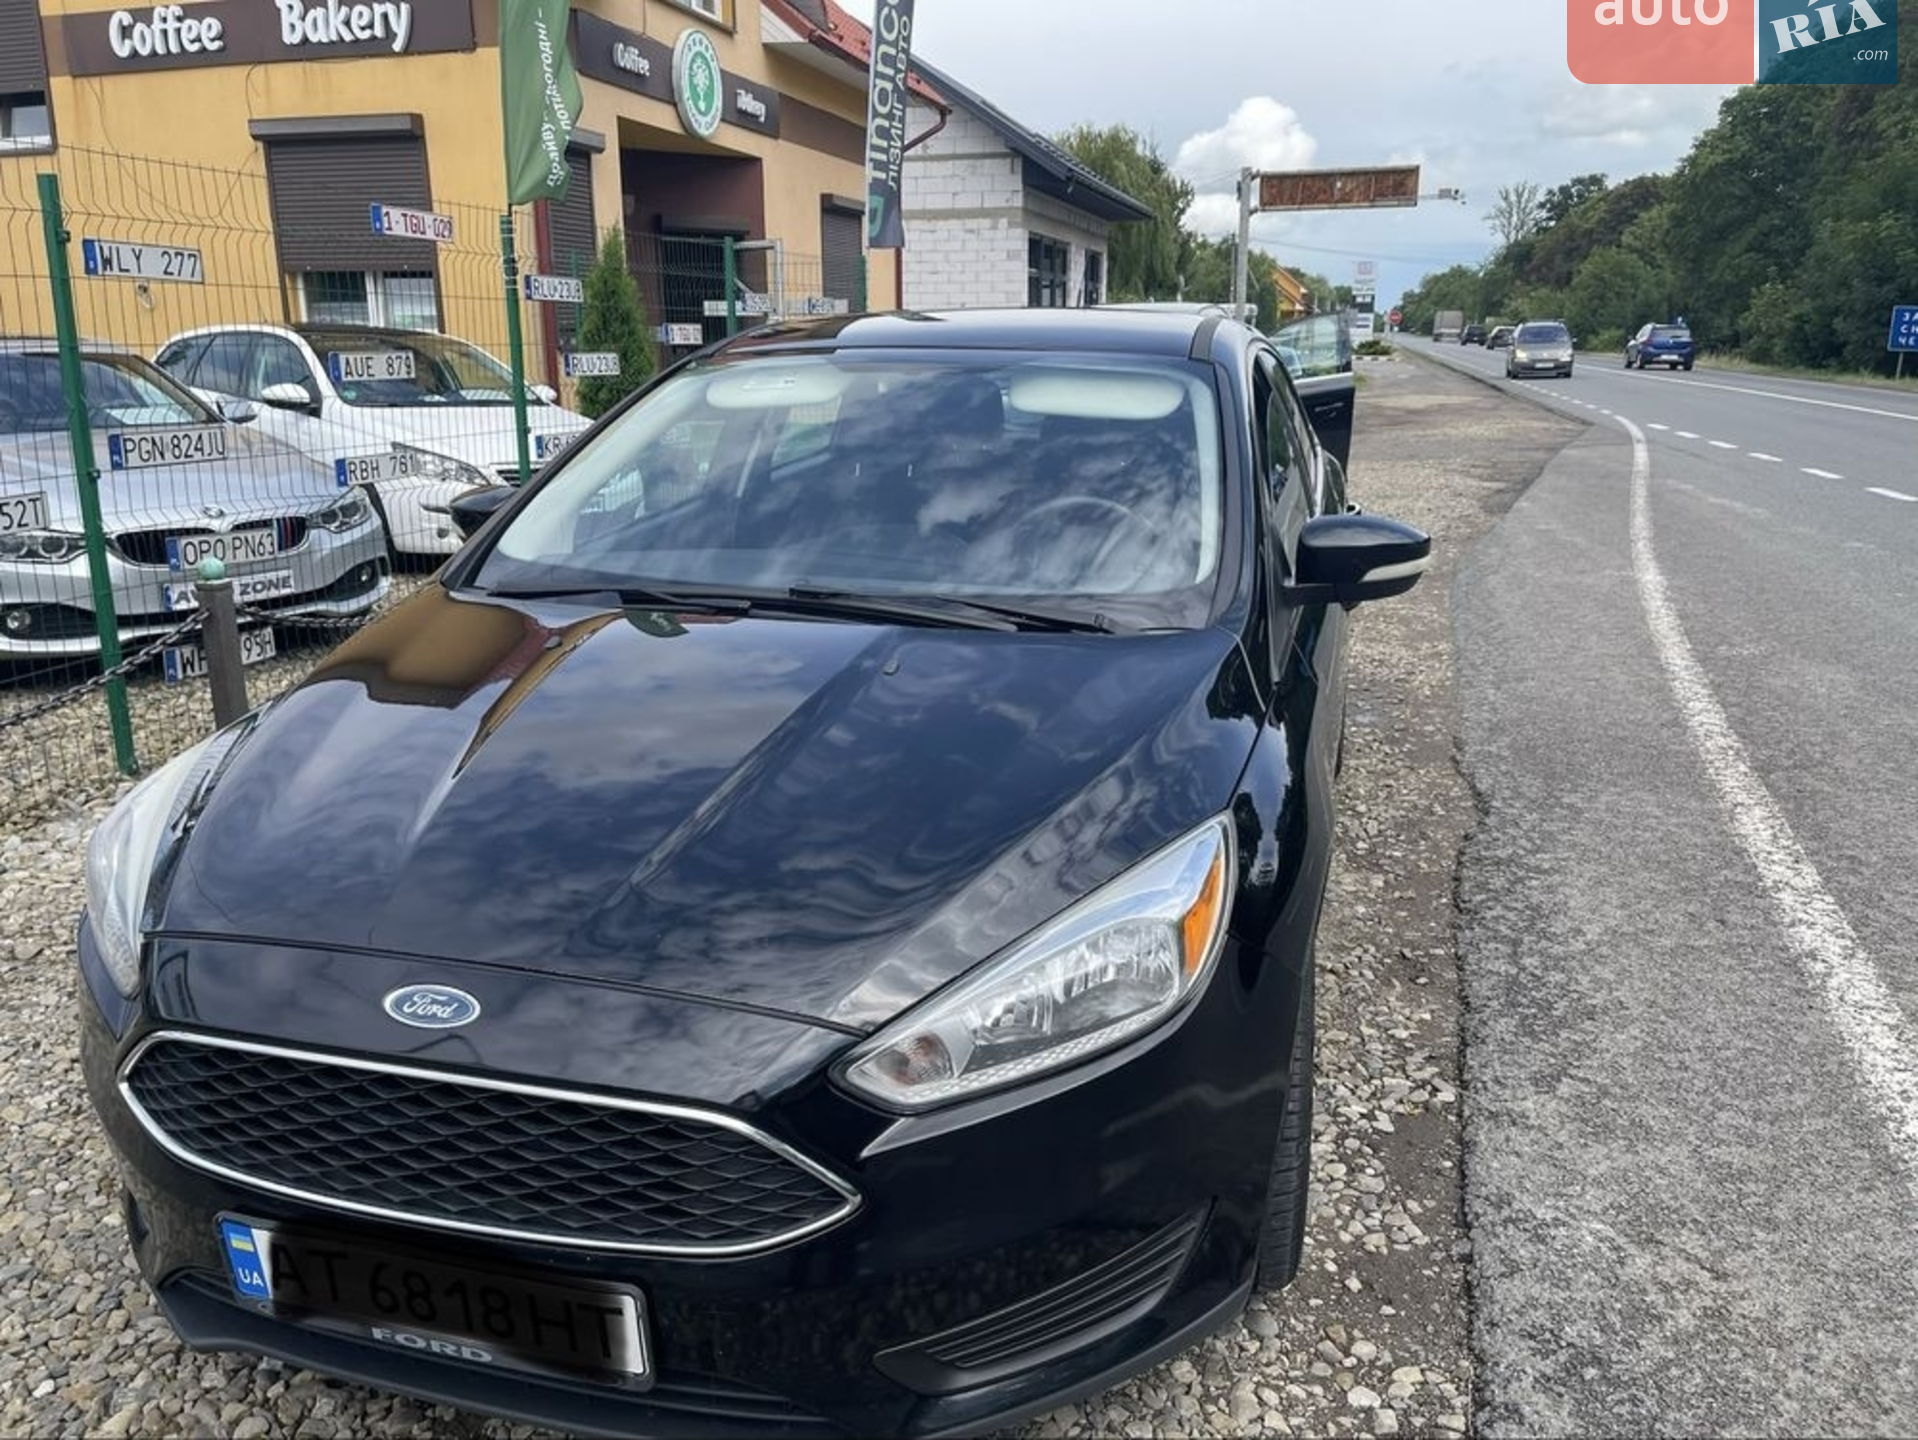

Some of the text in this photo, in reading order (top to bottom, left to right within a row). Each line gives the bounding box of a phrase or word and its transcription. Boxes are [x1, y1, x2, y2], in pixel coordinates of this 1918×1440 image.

[109, 0, 411, 57] Coffee Bakery
[895, 16, 911, 91] АВТО
[868, 0, 899, 184] financ
[99, 245, 198, 278] WLY 277
[345, 354, 412, 378] AUE 879
[123, 429, 225, 465] PGN 824JU
[348, 454, 415, 482] RBH 761
[232, 533, 275, 561] PN63
[240, 575, 292, 597] ZONE
[403, 992, 459, 1018] Ford
[238, 1267, 264, 1287] UA
[271, 1243, 623, 1360] AT 6818 HT
[371, 1326, 493, 1363] FORD
